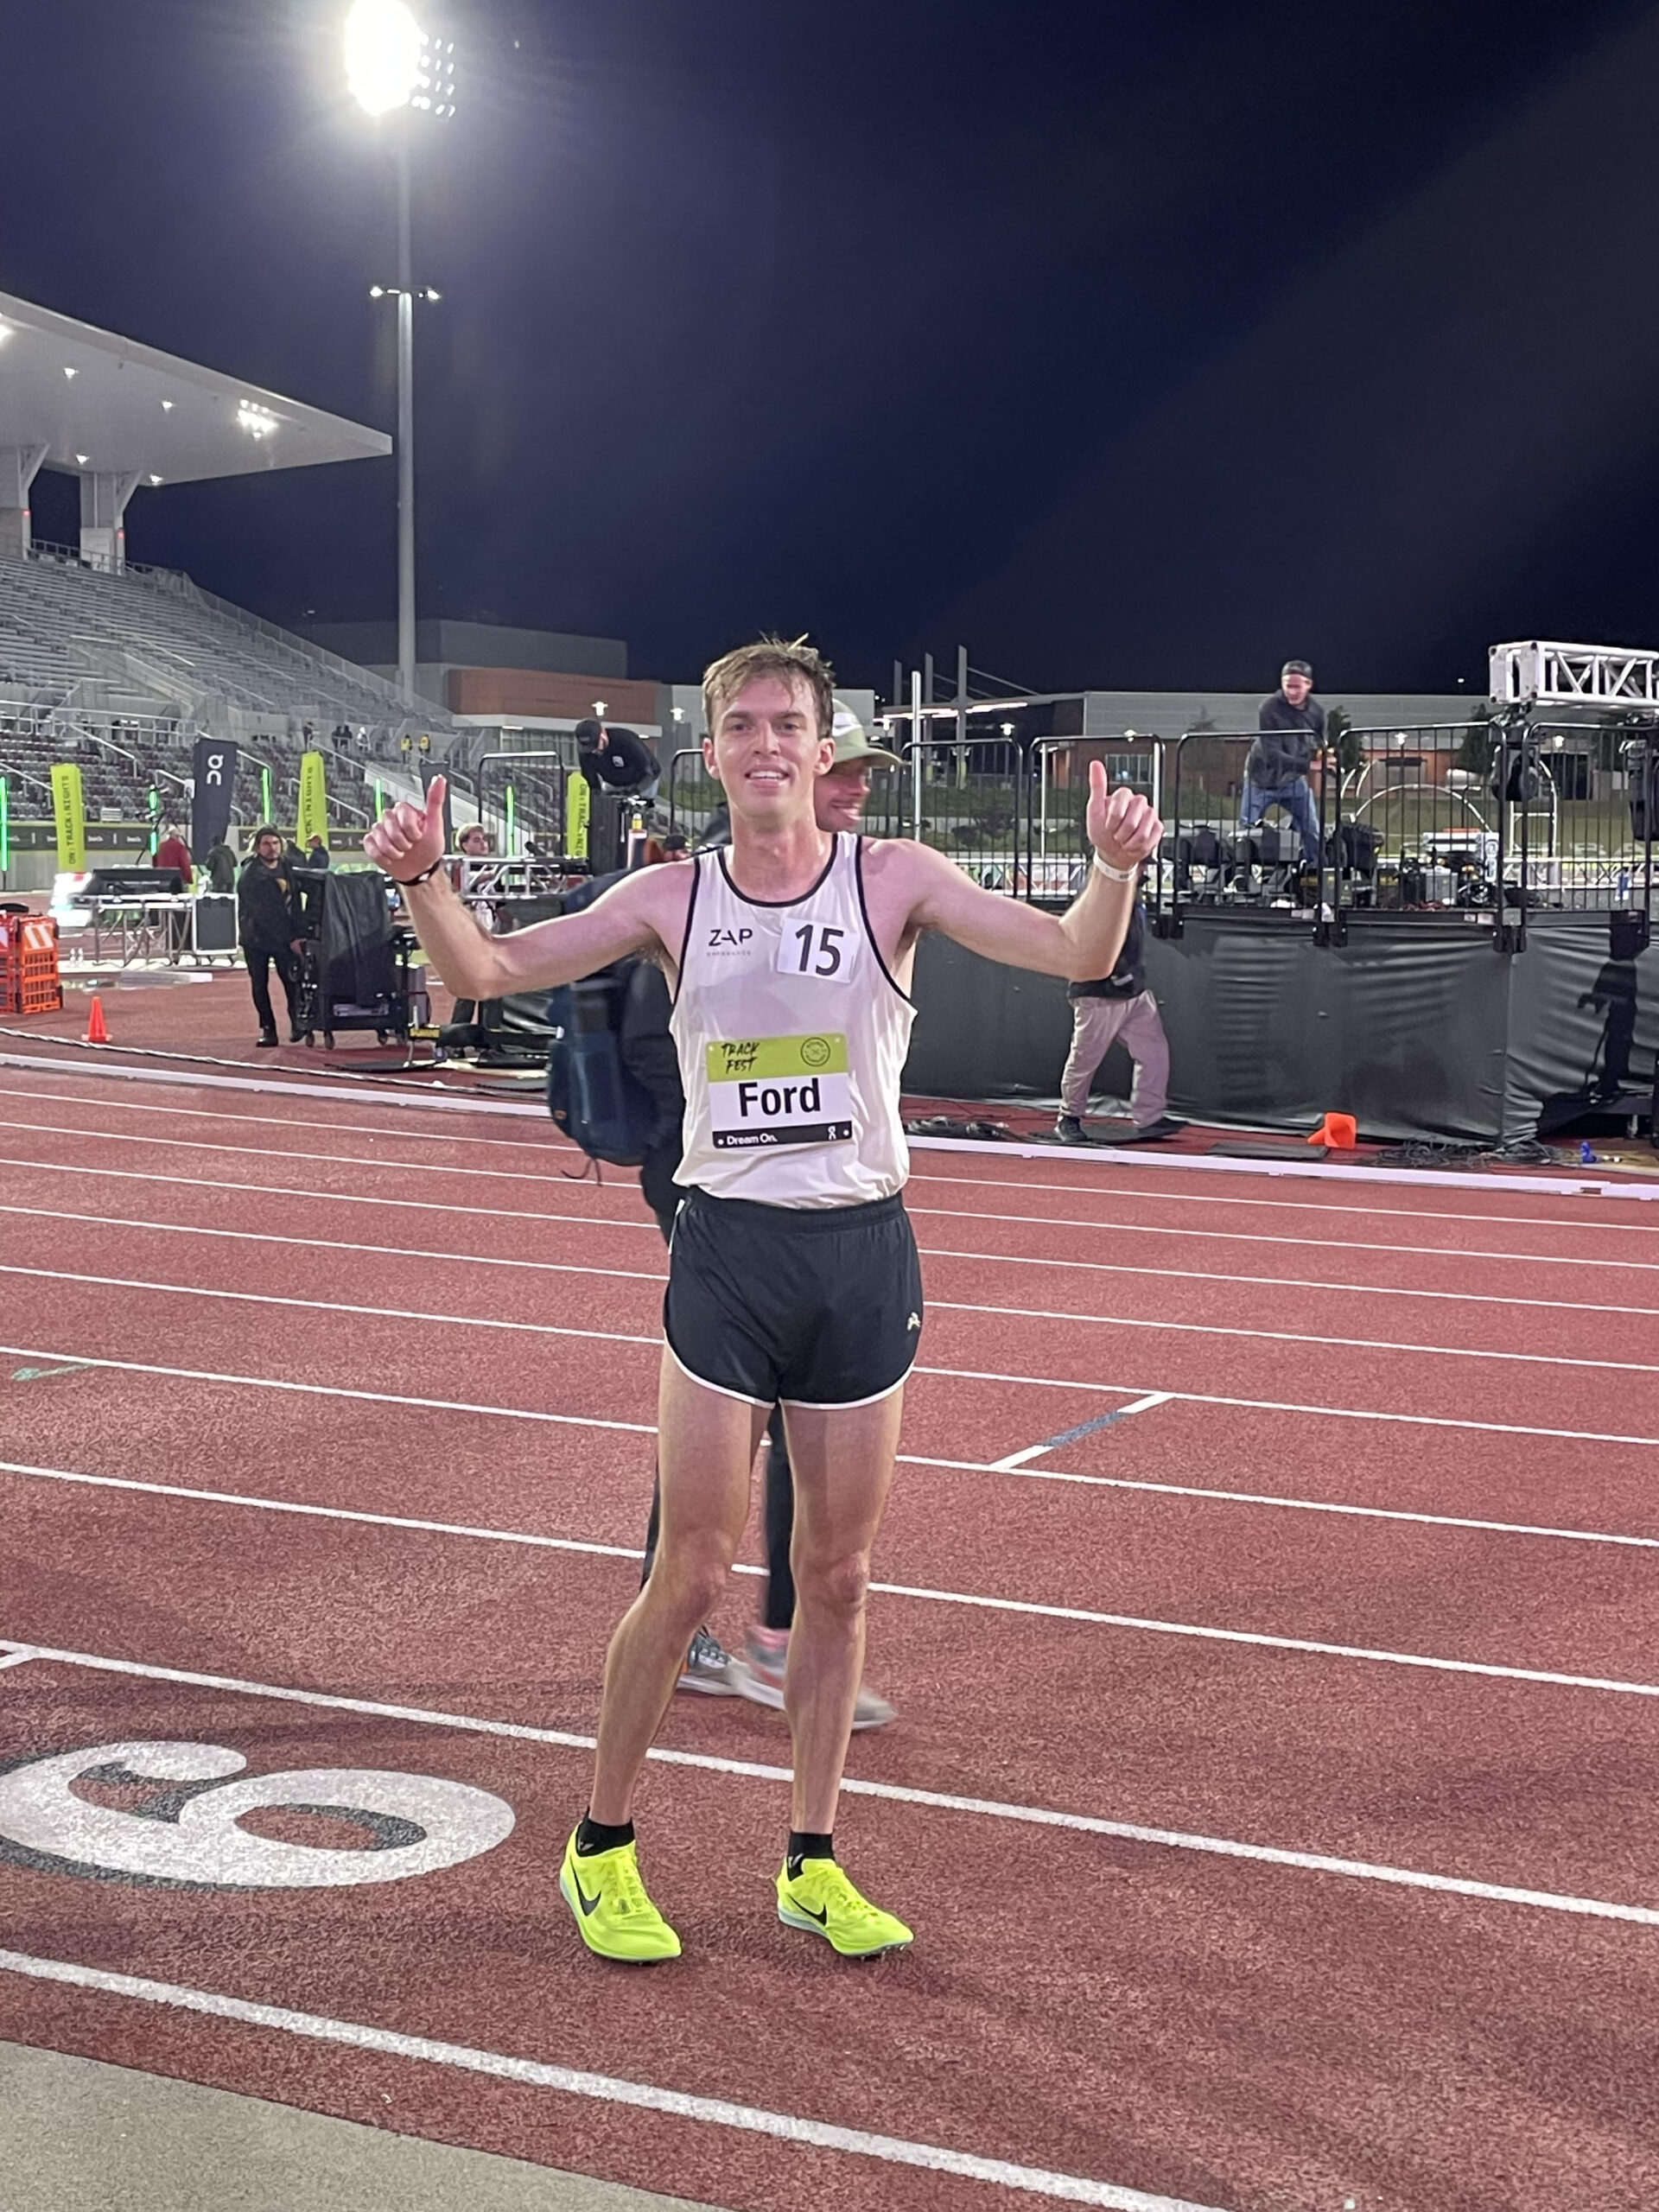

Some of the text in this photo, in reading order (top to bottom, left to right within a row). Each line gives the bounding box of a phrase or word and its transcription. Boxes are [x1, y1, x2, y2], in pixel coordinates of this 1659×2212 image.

[709, 928, 753, 946] ZAP
[795, 924, 844, 976] 15
[721, 1042, 760, 1057] TRACK
[726, 1057, 758, 1074] FEST
[739, 1077, 821, 1116] Ford
[727, 1135, 759, 1145] Dream
